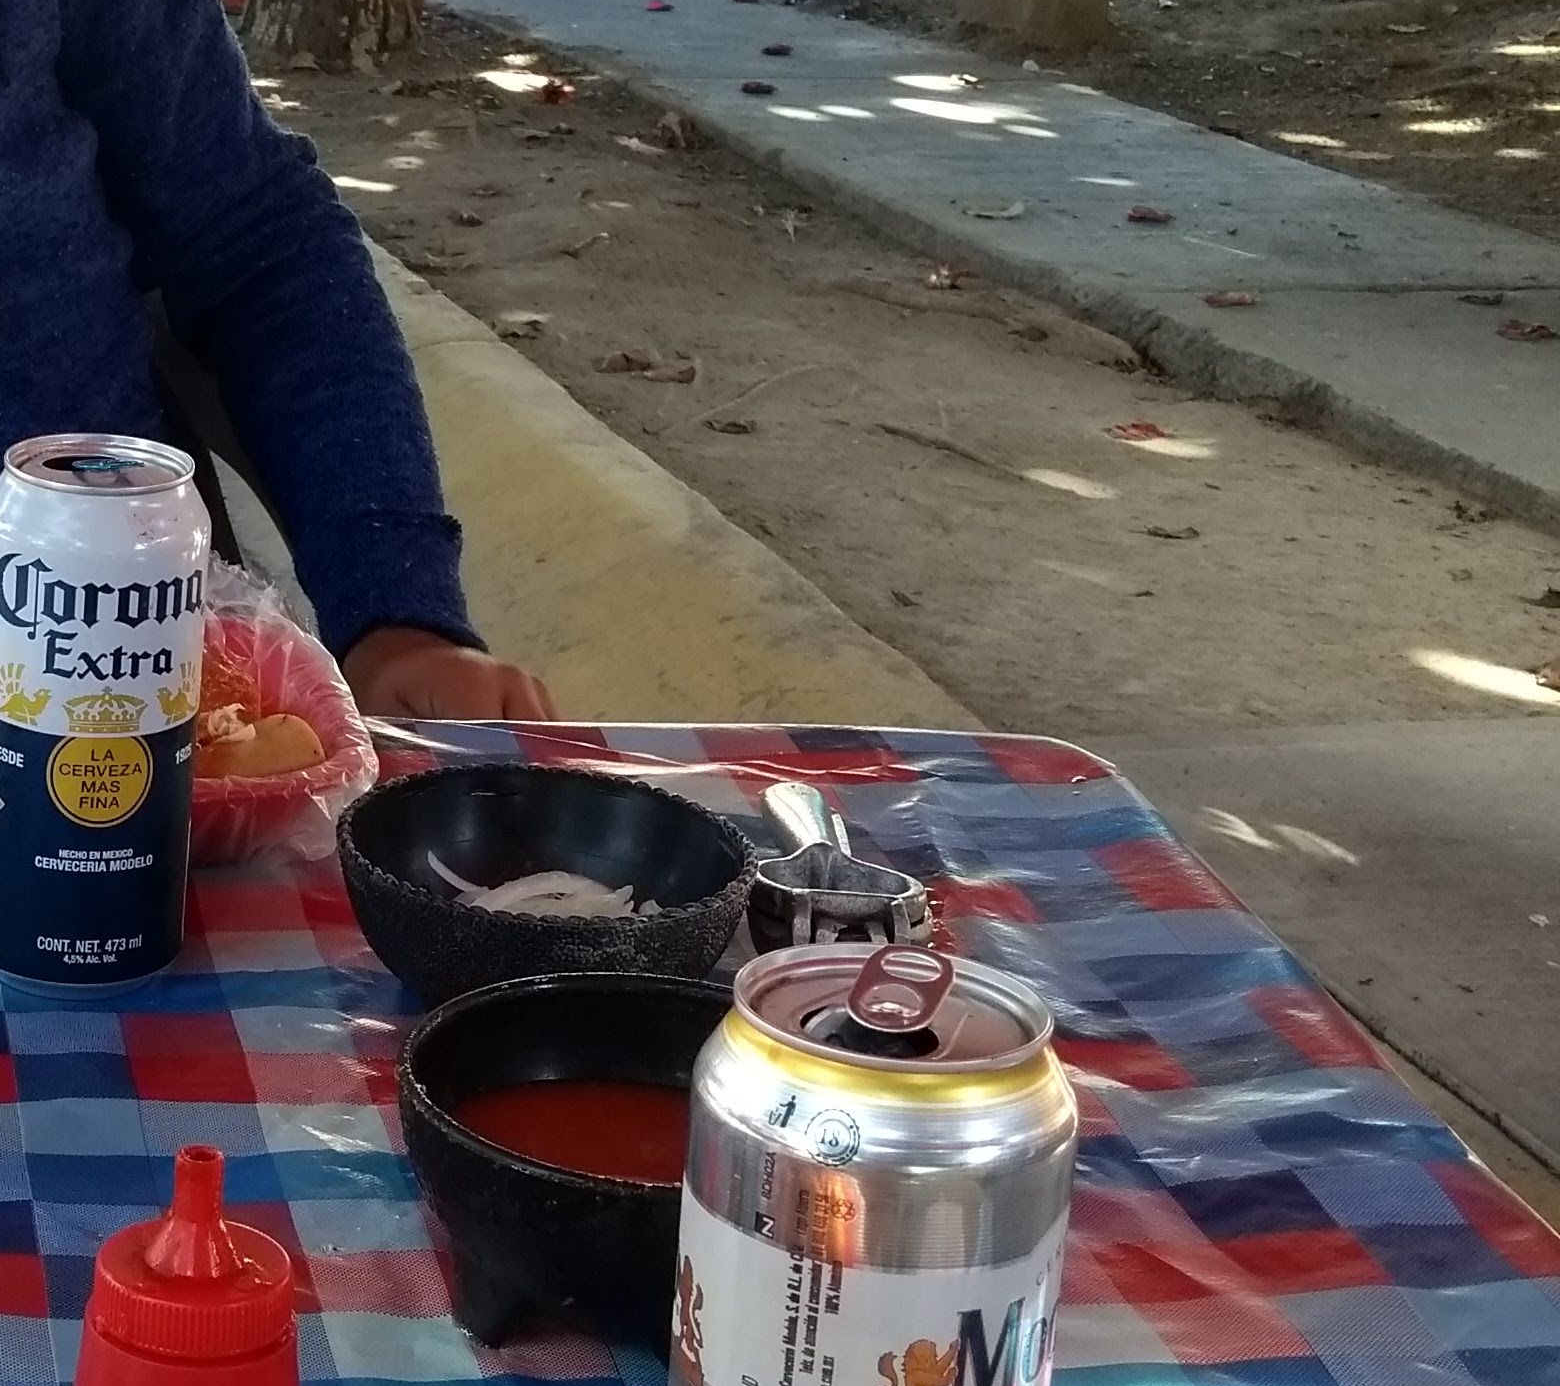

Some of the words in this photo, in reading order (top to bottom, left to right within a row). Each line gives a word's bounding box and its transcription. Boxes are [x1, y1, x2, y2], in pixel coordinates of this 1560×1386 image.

[42, 629, 173, 680] Extra
[90, 748, 115, 762] LA
[58, 762, 143, 777] CERVEZA
[80, 780, 121, 794] MAS
[78, 796, 121, 810] FINA
[58, 849, 87, 860] HECHO
[89, 851, 100, 860] EN
[102, 848, 133, 860] MEXICO
[34, 856, 107, 872] CERVECERIA
[109, 854, 153, 871] MODELO
[37, 935, 72, 953] CONT.
[75, 939, 101, 953] NET.
[105, 937, 127, 952] 473
[128, 934, 142, 949] ml
